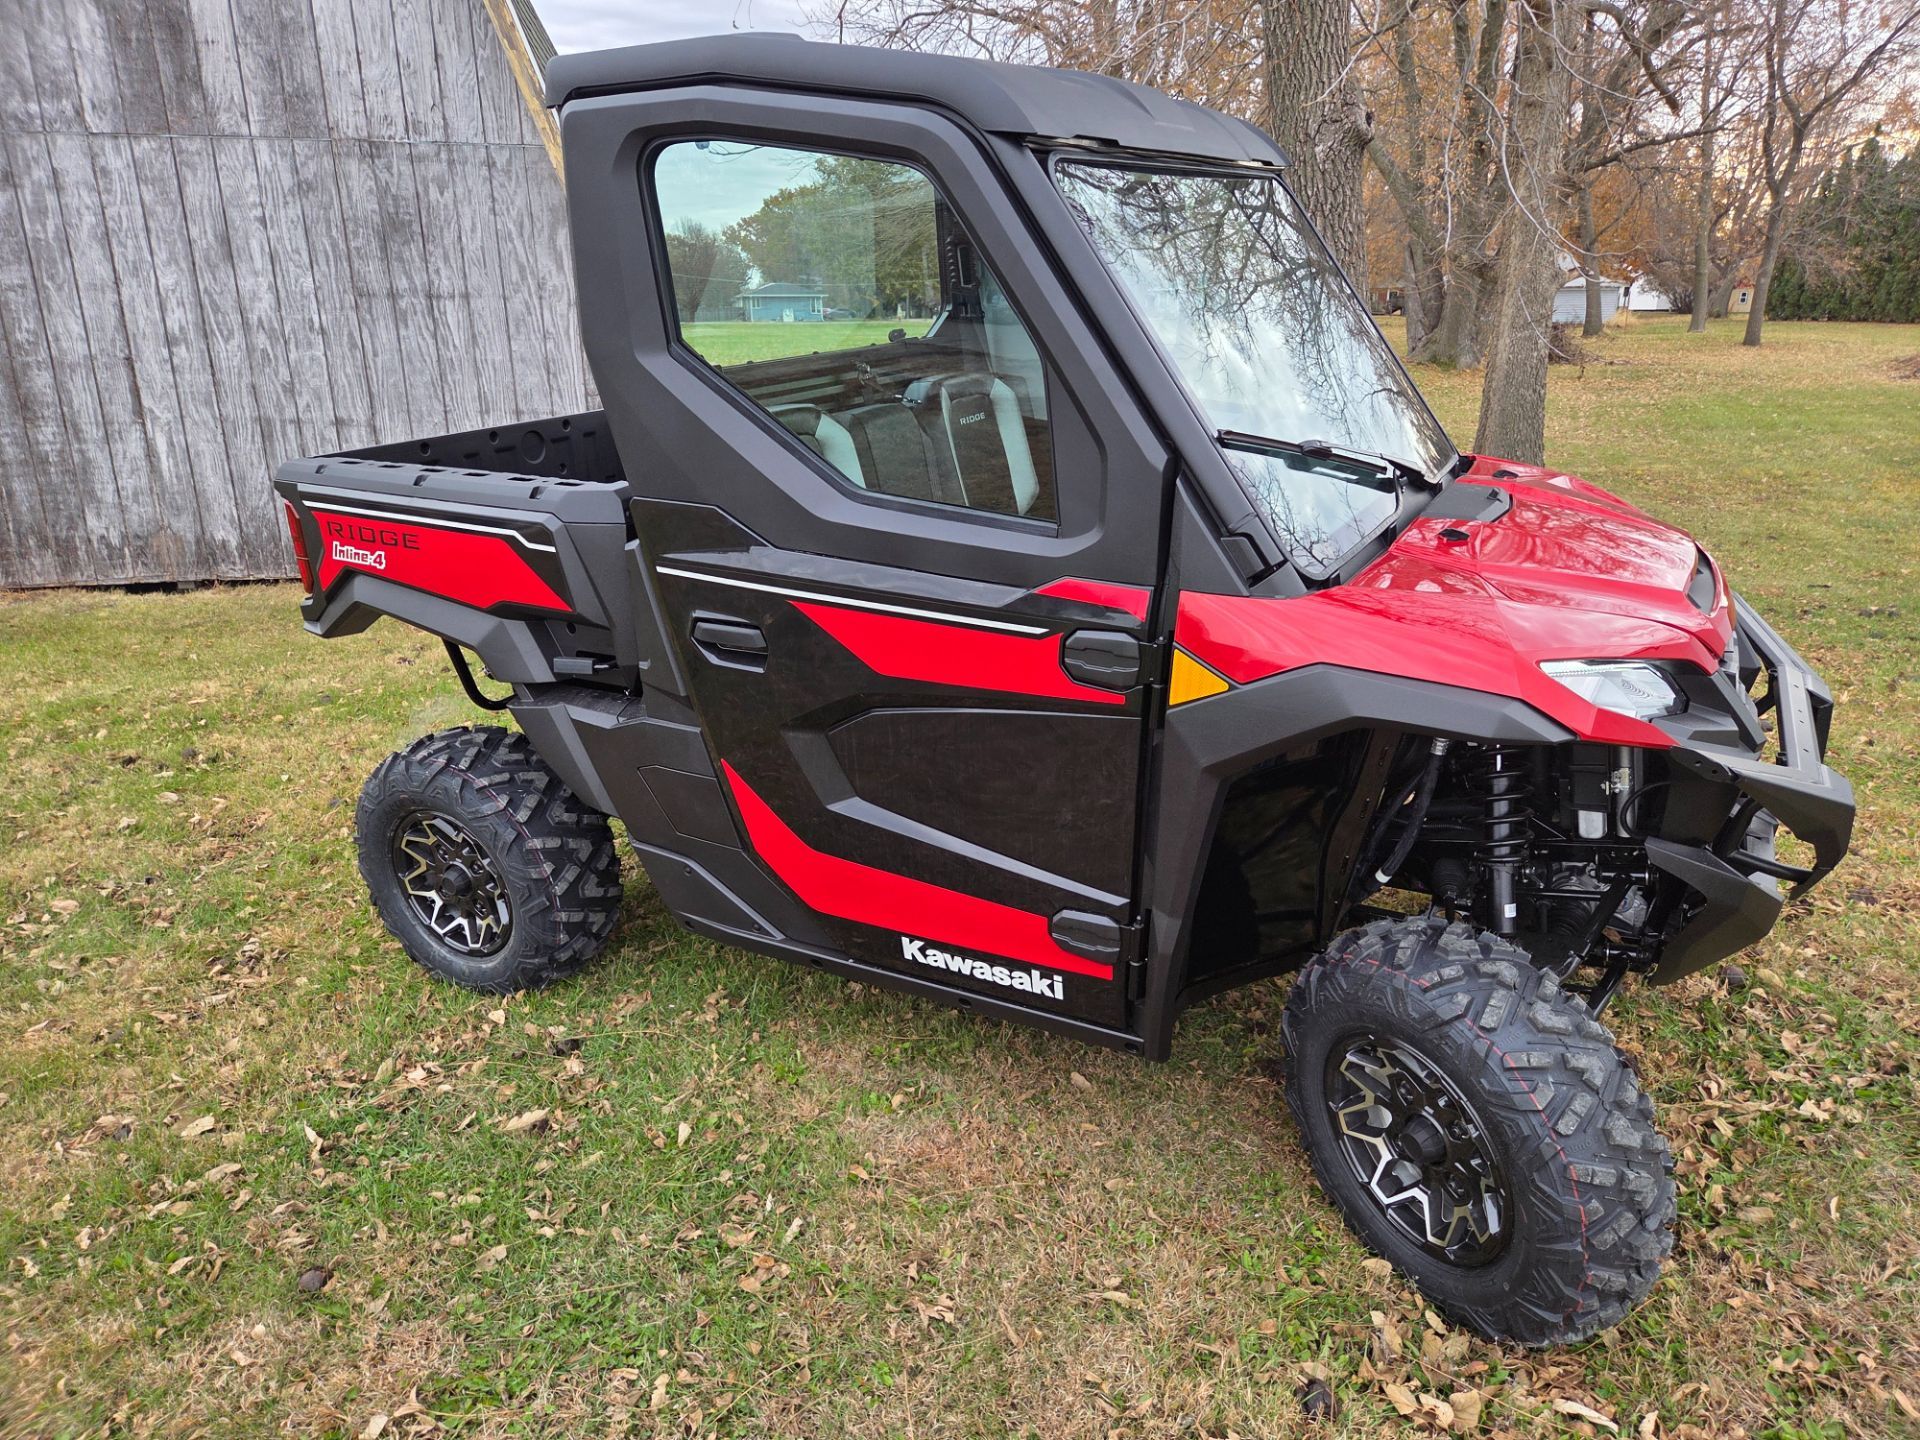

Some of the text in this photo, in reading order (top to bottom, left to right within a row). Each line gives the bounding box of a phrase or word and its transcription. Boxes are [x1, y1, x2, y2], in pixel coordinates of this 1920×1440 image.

[960, 412, 986, 425] RIDGE
[326, 521, 420, 550] RIDGE
[333, 541, 386, 569] Inline-4
[901, 936, 1064, 1001] Kawasaki
